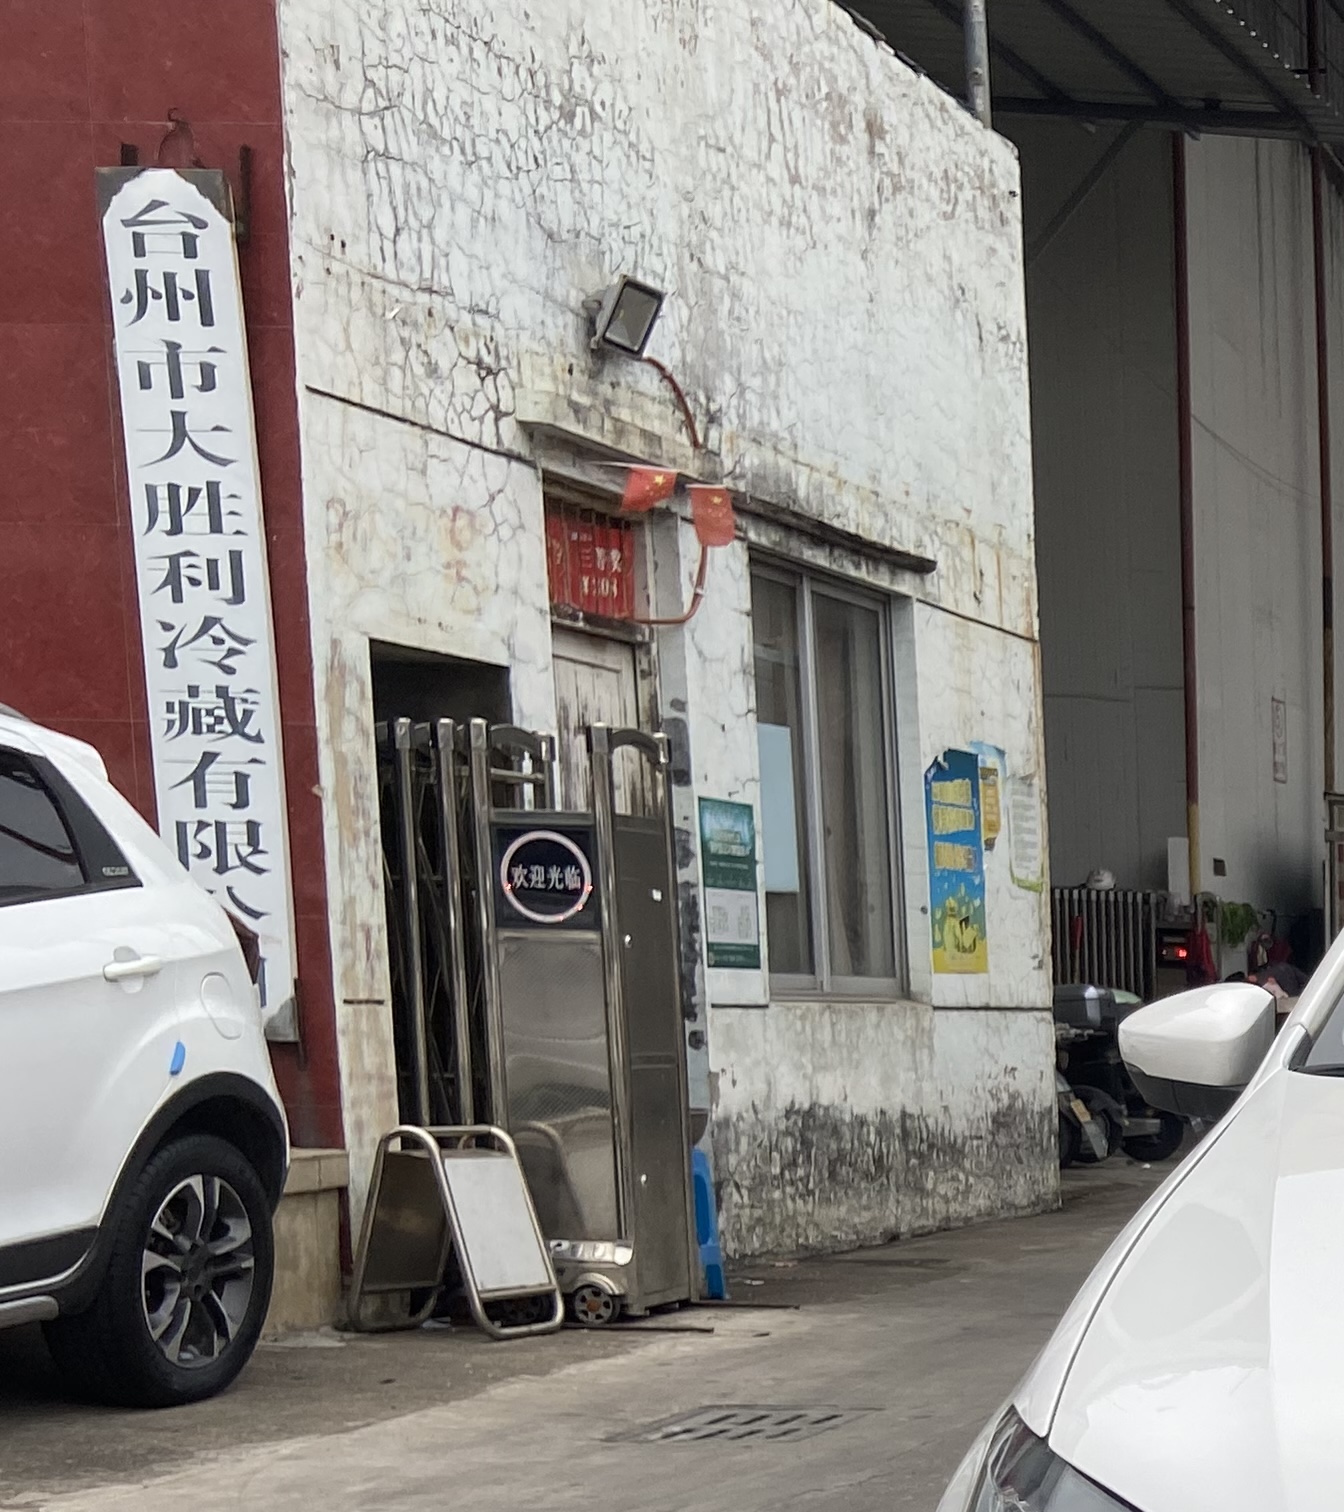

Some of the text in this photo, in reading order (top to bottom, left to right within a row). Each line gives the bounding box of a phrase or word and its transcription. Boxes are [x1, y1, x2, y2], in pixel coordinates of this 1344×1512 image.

[120, 199, 271, 1008] 台州市大胜利冷藏有限
[511, 863, 581, 891] 欢迎光临
